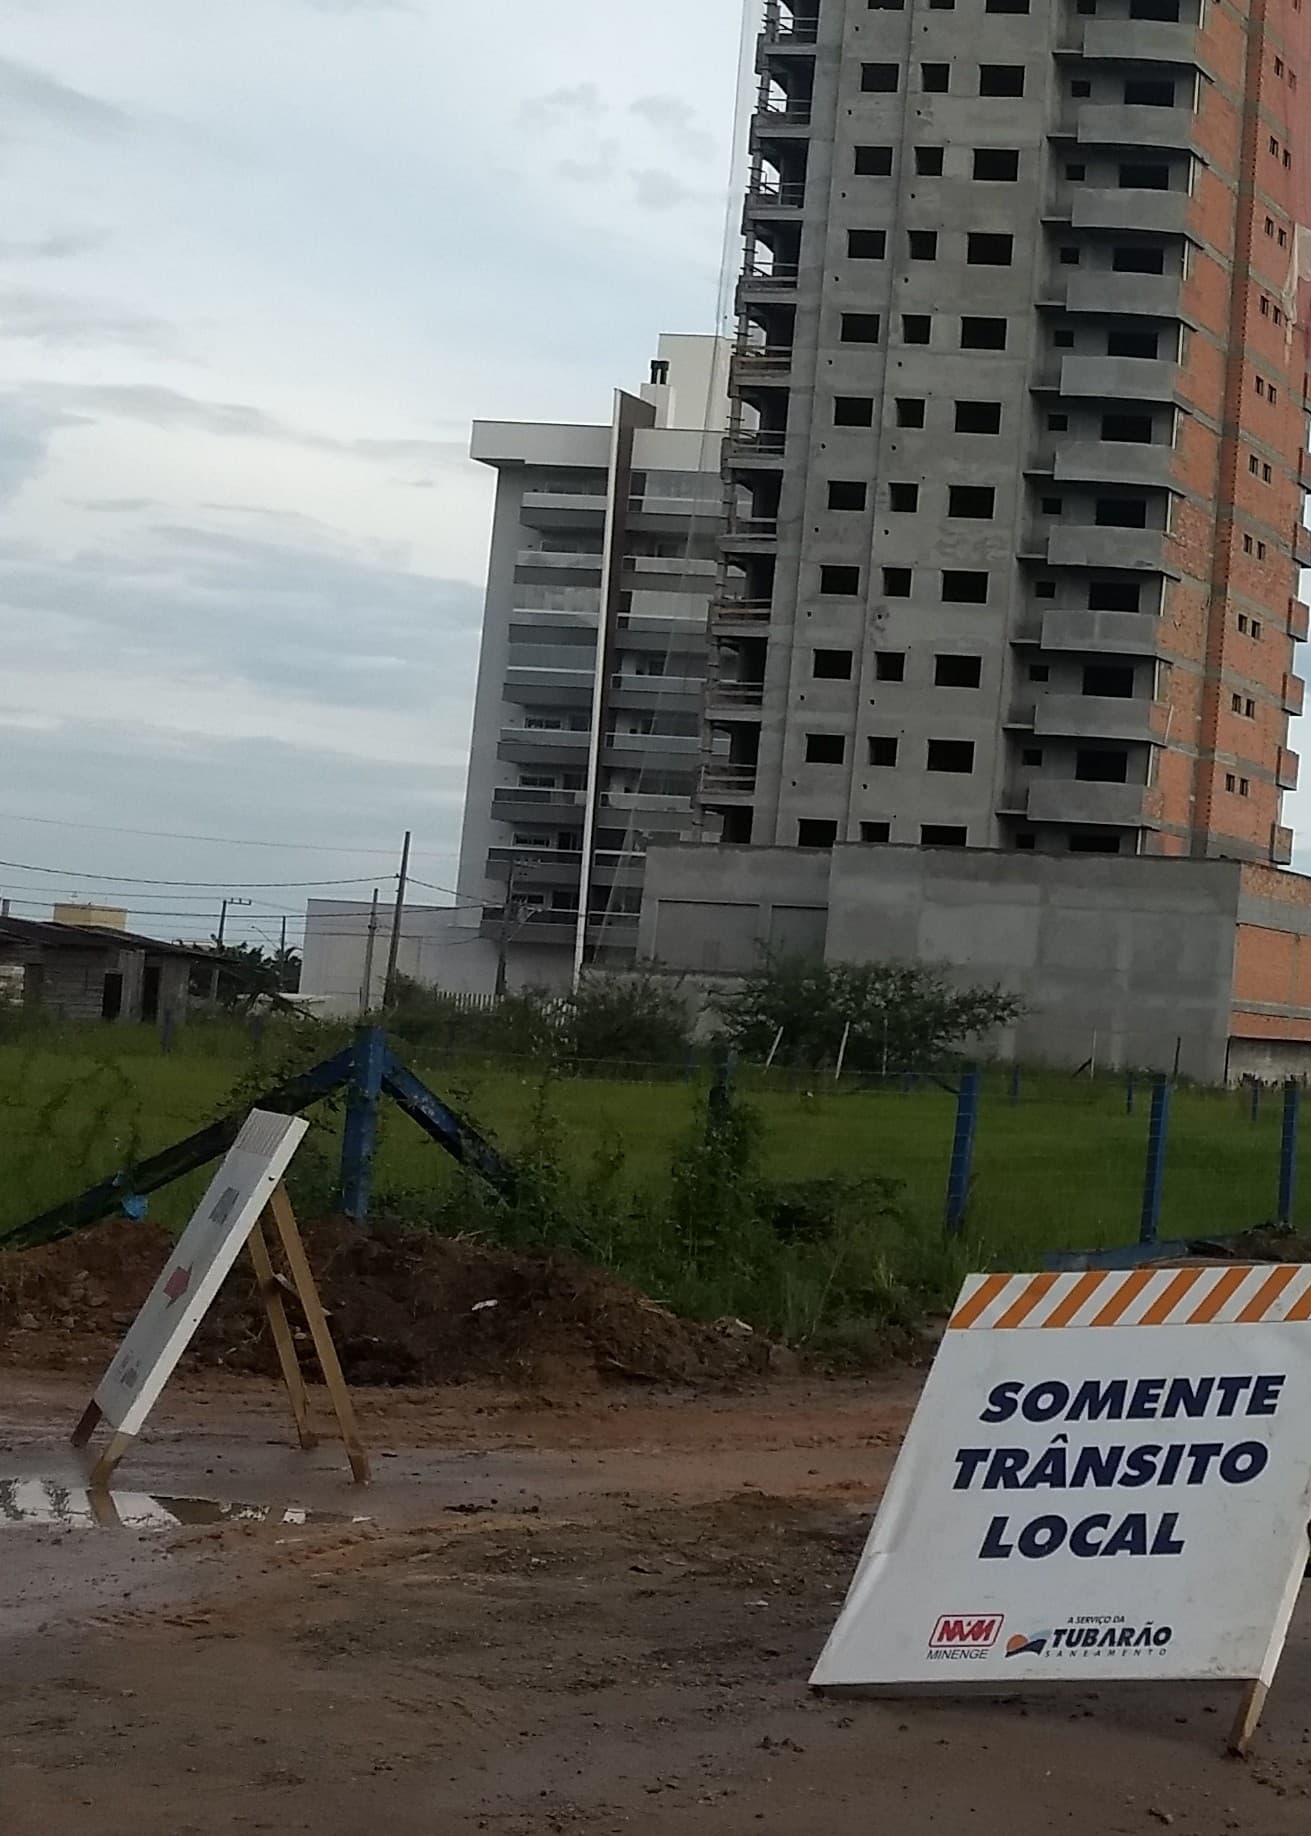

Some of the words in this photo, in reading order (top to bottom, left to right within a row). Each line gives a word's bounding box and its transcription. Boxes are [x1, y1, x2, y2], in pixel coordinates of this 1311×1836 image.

[979, 1375, 1286, 1423] SOMENTE
[952, 1433, 1268, 1490] TRÂNSITO
[978, 1512, 1185, 1559] LOCAL
[1052, 1620, 1172, 1648] TUBARÃO
[1075, 1616, 1111, 1625] SERVIÇO
[1112, 1615, 1125, 1623] DA
[926, 1649, 989, 1660] MINENGE
[1045, 1648, 1167, 1658] SANEAMENTO
